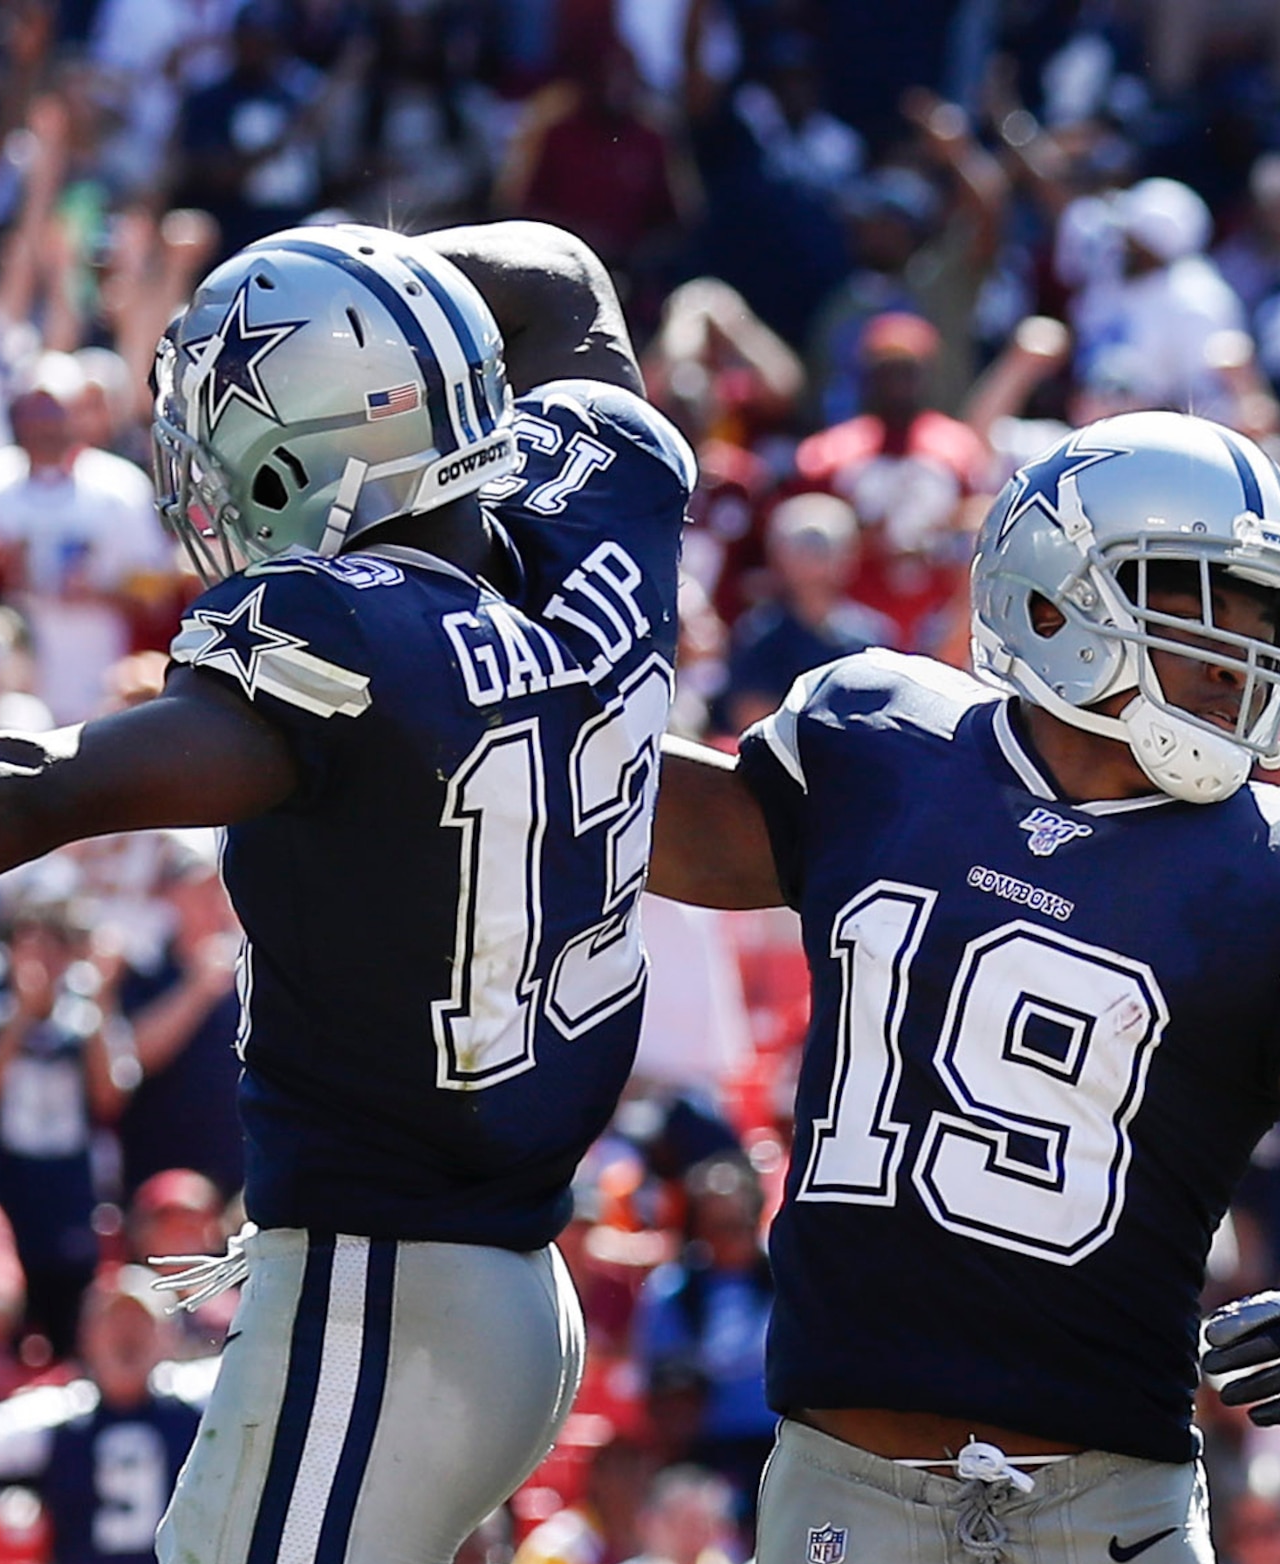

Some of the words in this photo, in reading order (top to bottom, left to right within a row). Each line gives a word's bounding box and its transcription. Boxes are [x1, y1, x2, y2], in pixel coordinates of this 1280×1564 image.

[431, 652, 675, 1091] 13
[967, 866, 1075, 921] COWBOYS
[795, 879, 1170, 1267] 19
[93, 1422, 166, 1554] 9
[811, 1542, 841, 1564] NFL
